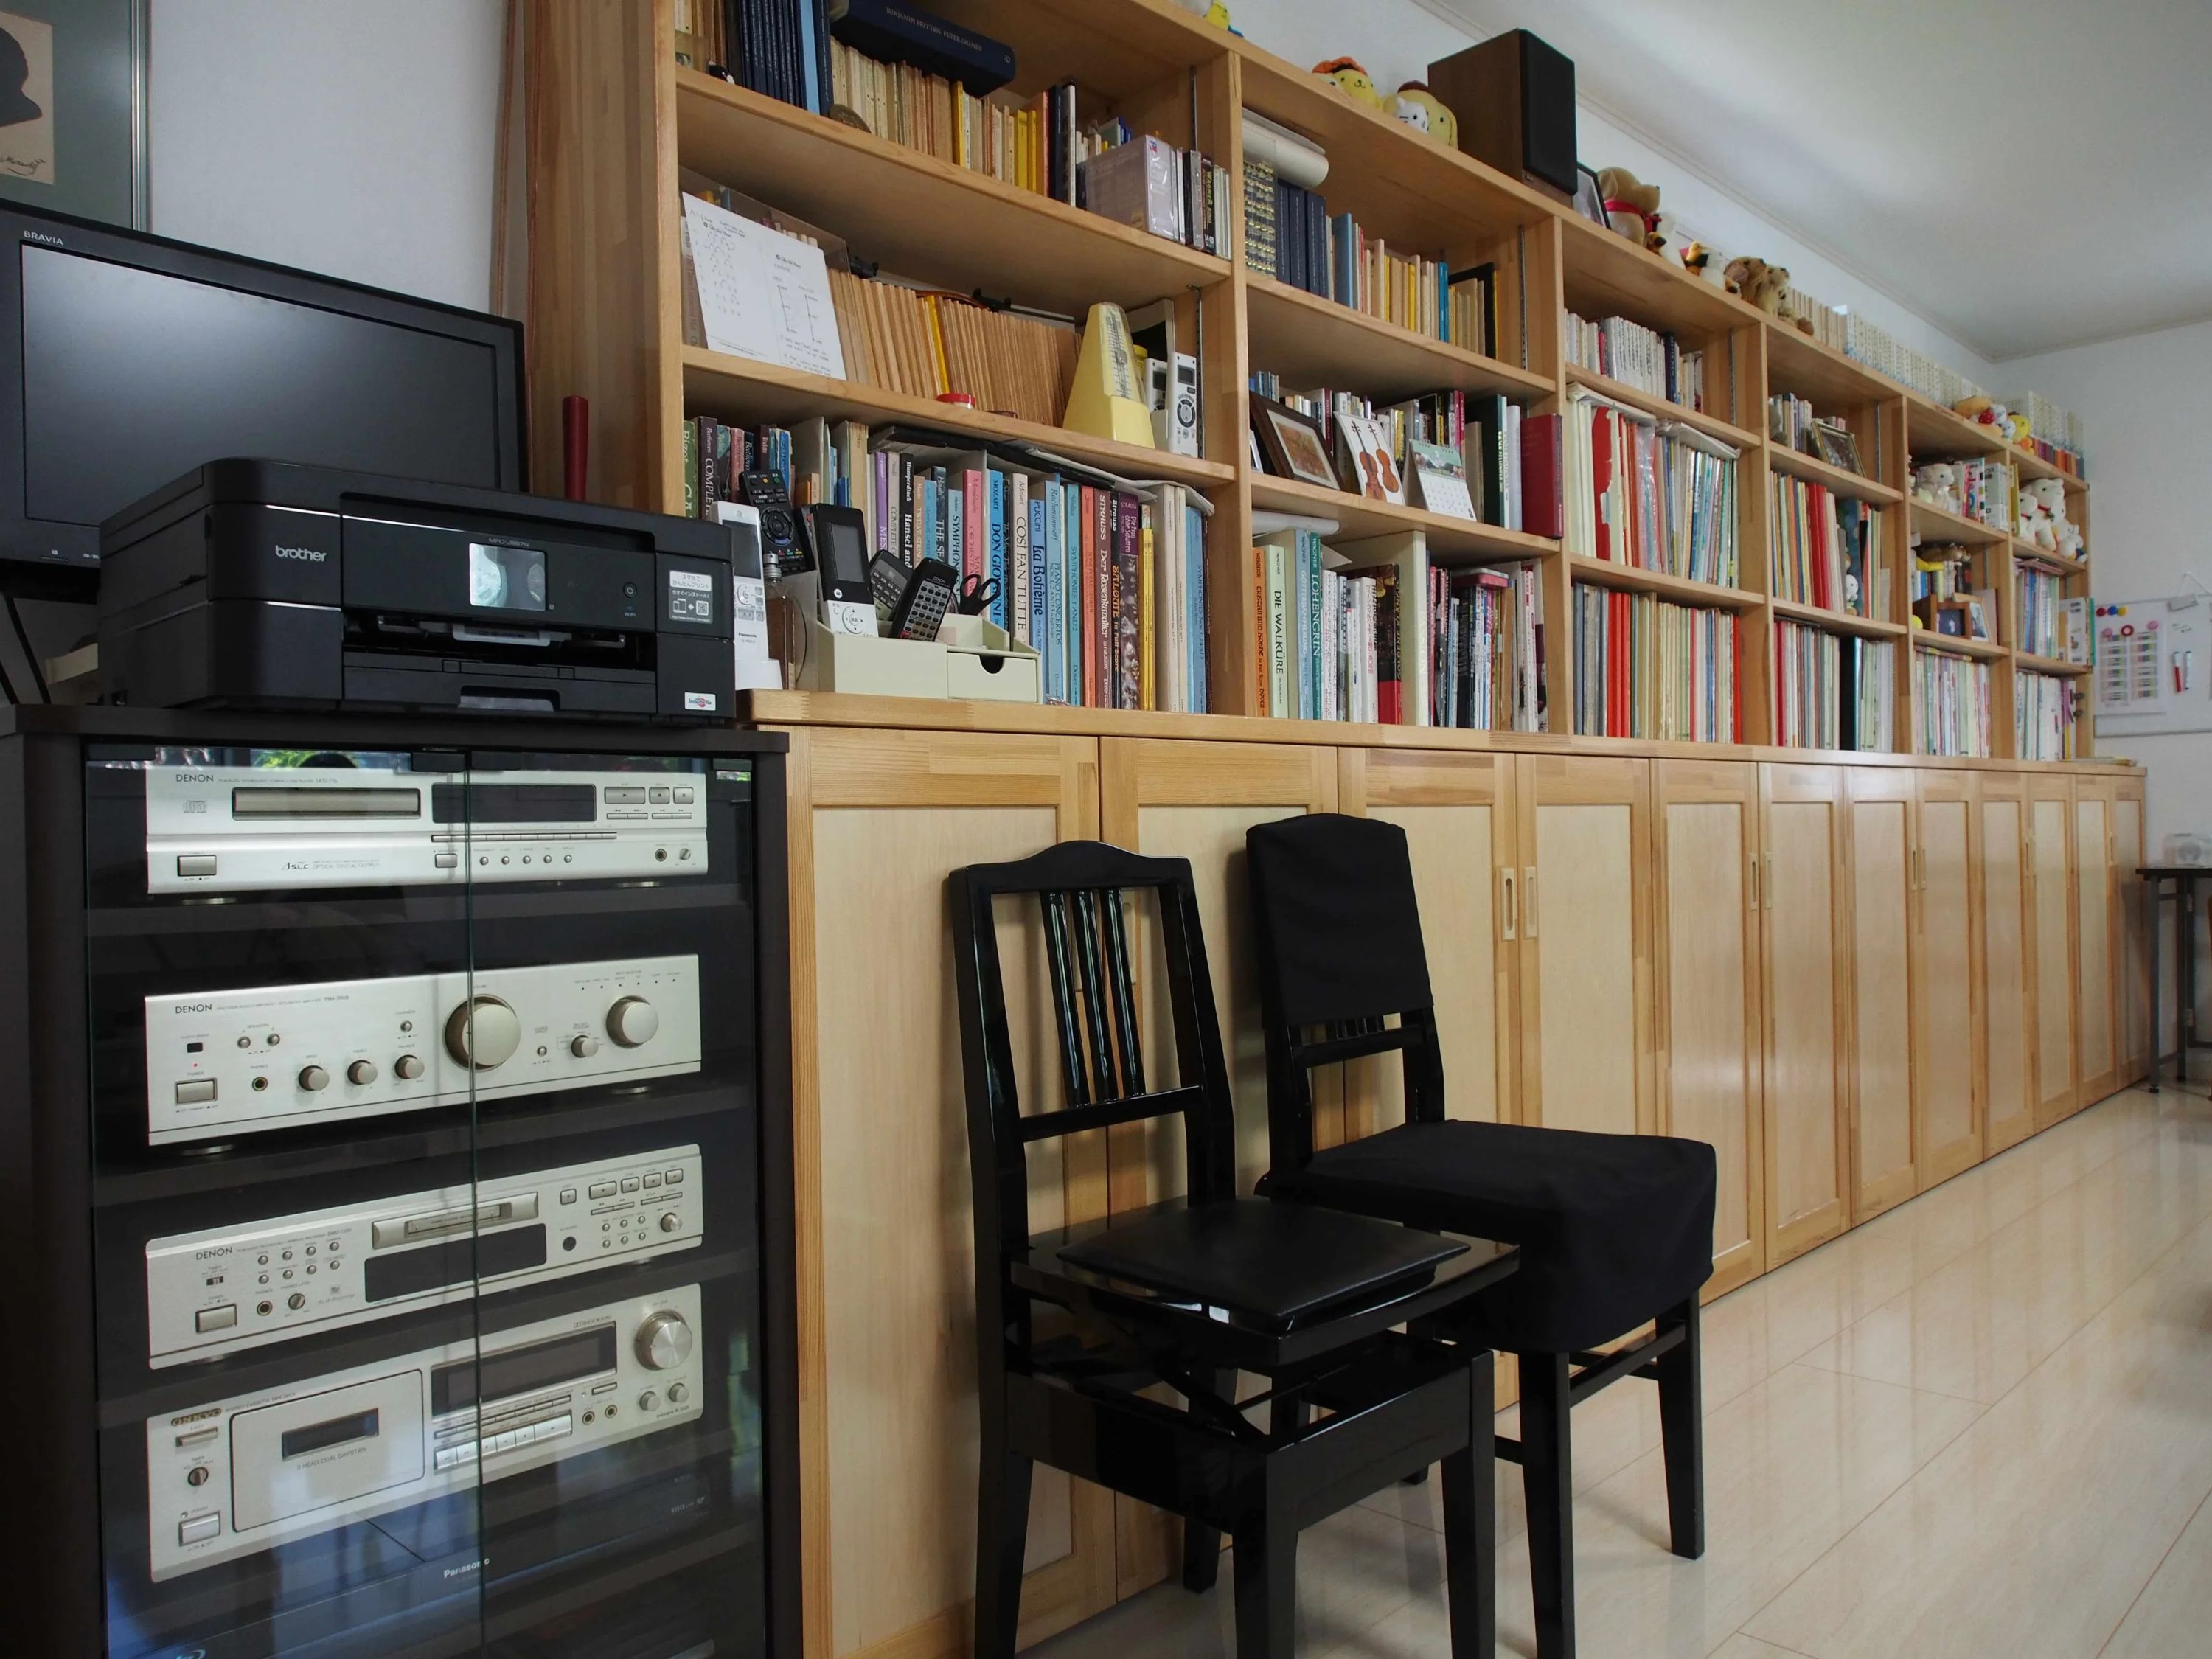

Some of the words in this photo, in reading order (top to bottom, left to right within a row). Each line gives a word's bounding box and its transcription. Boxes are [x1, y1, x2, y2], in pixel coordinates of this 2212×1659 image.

[886, 7, 916, 25] BENJAMIN
[943, 30, 961, 44] PETER
[961, 38, 983, 52] GRIMES
[23, 230, 64, 246] BRAVIA
[1034, 501, 1042, 532] PUCCINI
[1050, 488, 1060, 541] Rachmaninoff
[1099, 494, 1107, 540] STRAUSS
[904, 514, 913, 547] Hansel
[936, 519, 945, 542] THE
[992, 524, 1001, 551] DON
[1124, 529, 1133, 553] Schatten
[275, 545, 327, 563] brother
[904, 549, 913, 568] and
[1032, 544, 1044, 561] La
[1099, 549, 1108, 571] Der
[1017, 553, 1026, 580] FAN
[672, 580, 710, 589] かんたんプリント
[1033, 565, 1046, 616] Bohème
[1112, 565, 1120, 619] SALOME
[1017, 585, 1026, 630] TUTTE
[1099, 572, 1109, 638] Rosenkavalier
[1273, 590, 1282, 609] DIE
[1054, 592, 1062, 646] CONCERTOS
[1311, 574, 1321, 656] LOHENGRIN
[1275, 613, 1285, 674] WALKÜRE
[175, 773, 214, 782] DENON
[175, 1004, 213, 1015] DENON
[195, 1246, 233, 1261] DENON
[171, 1408, 222, 1427] ONKYO
[302, 1460, 319, 1469] HEAD
[321, 1455, 336, 1464] DUAL
[338, 1447, 366, 1459] CAPSTAN
[443, 1557, 491, 1579] Panasonc
